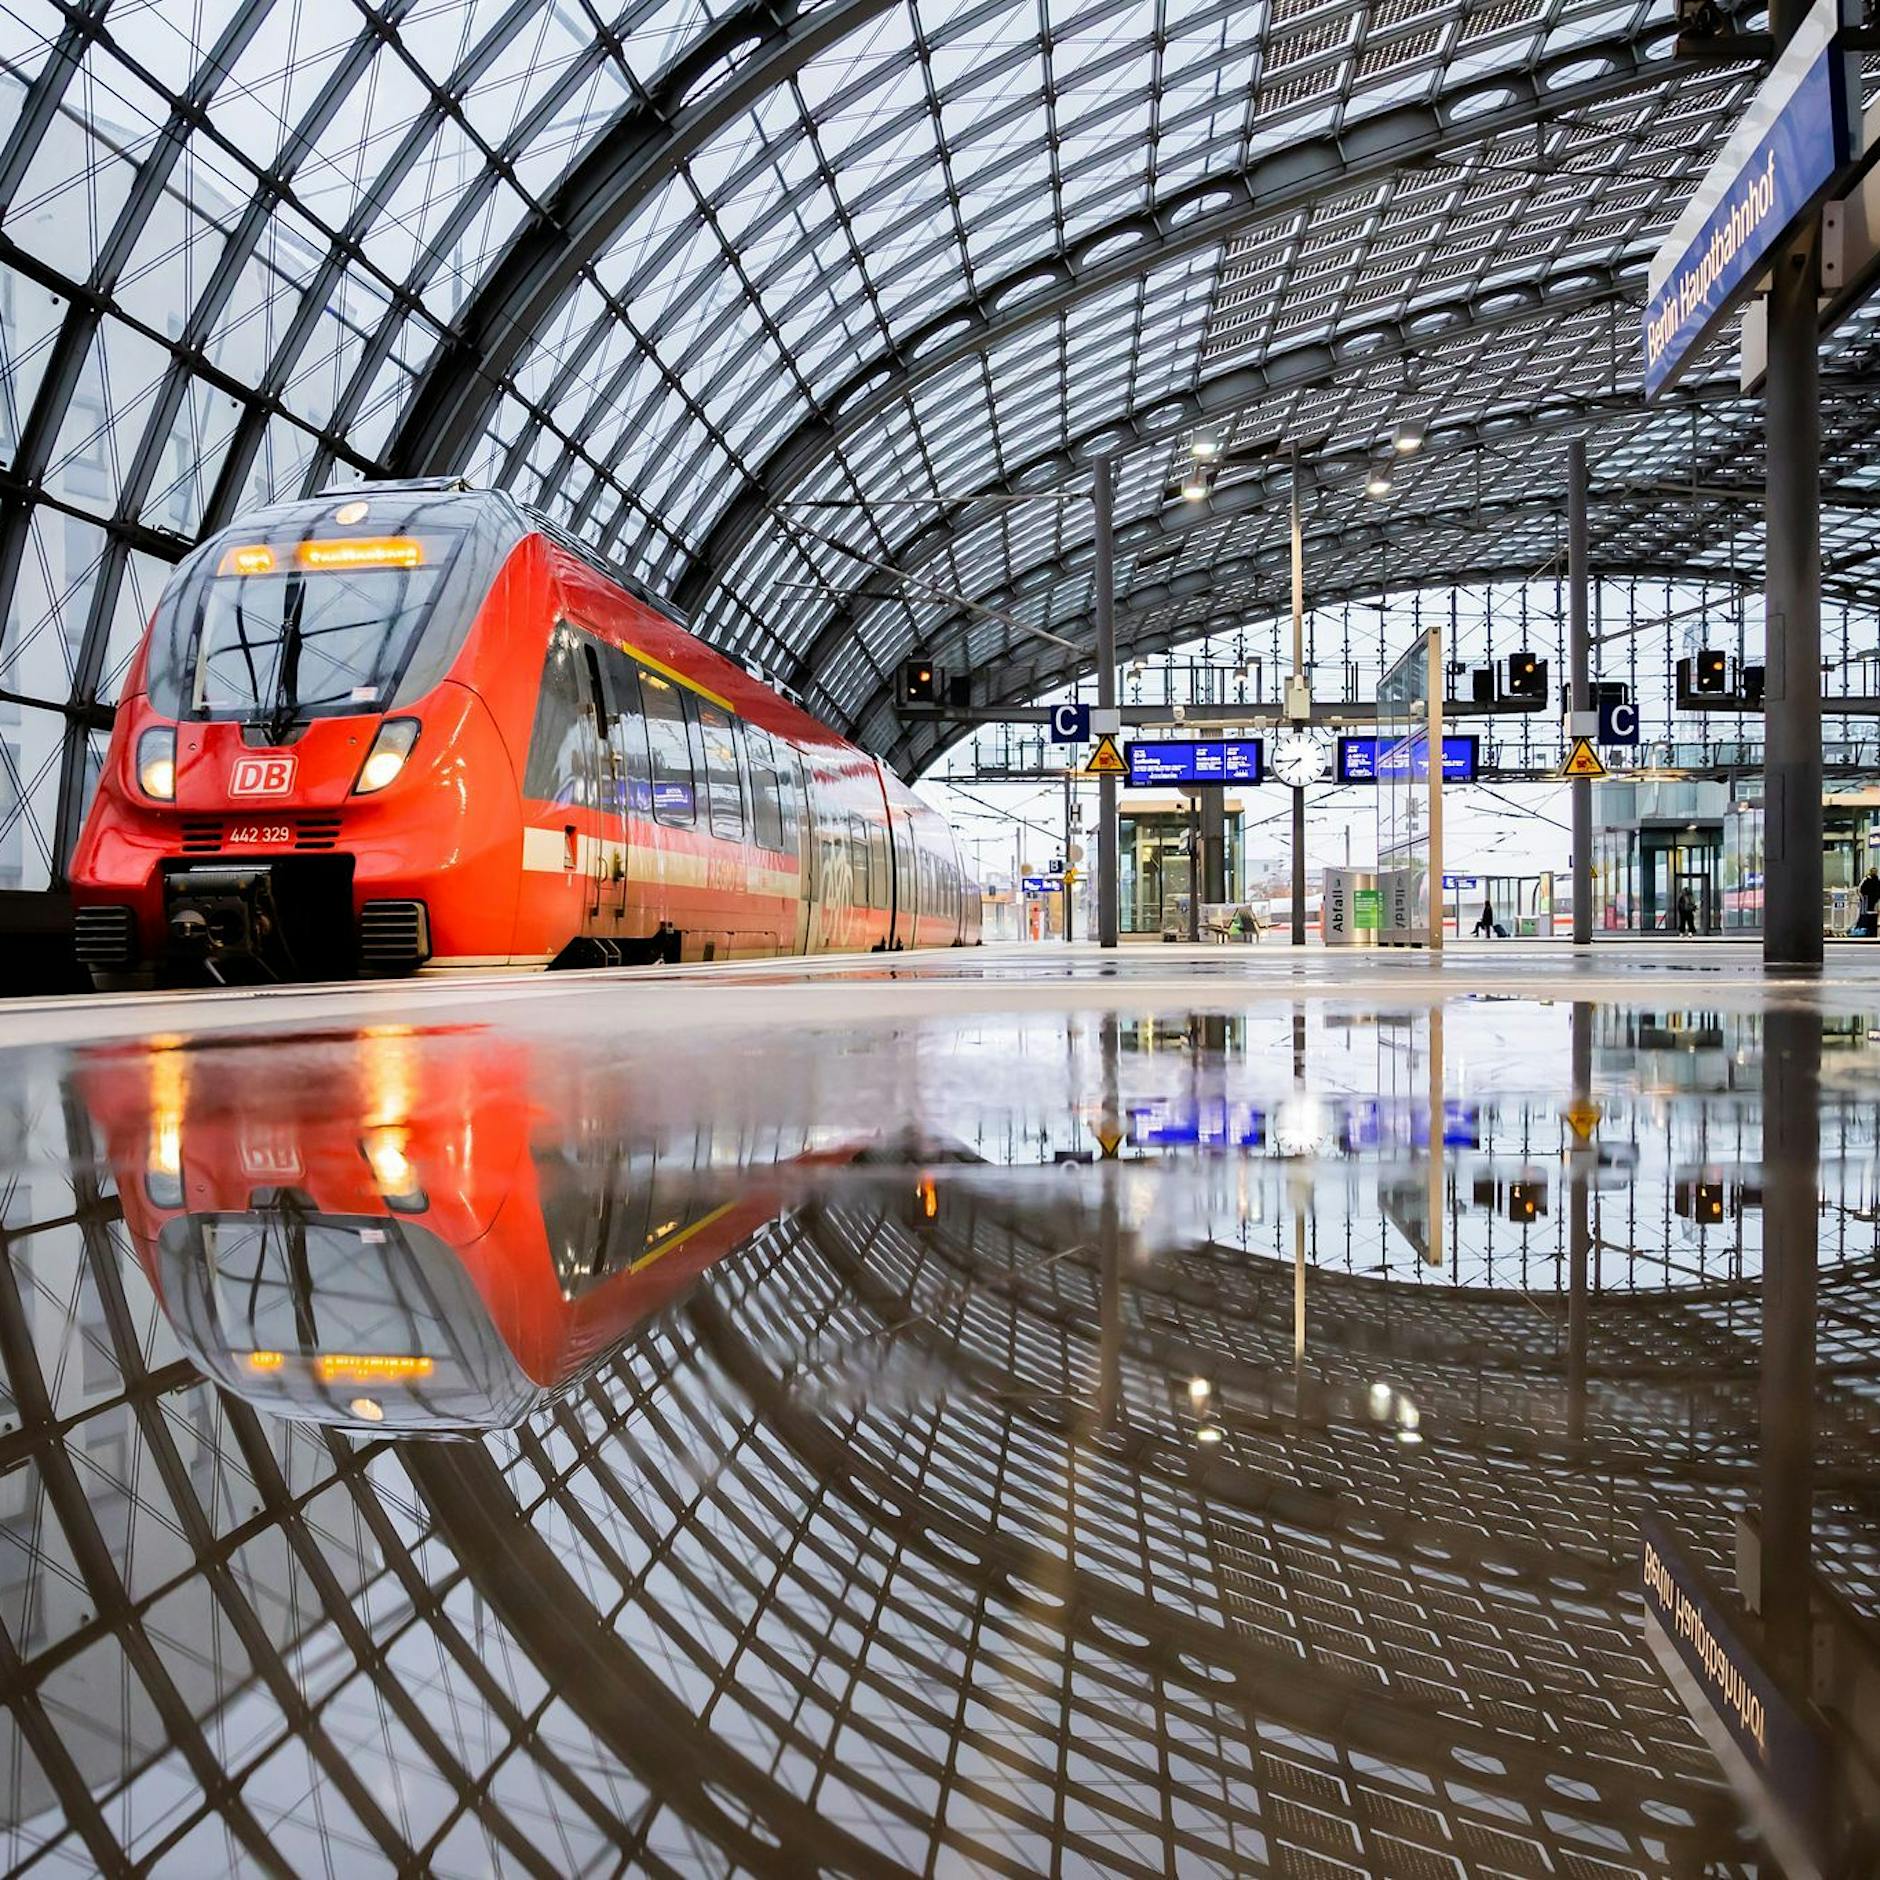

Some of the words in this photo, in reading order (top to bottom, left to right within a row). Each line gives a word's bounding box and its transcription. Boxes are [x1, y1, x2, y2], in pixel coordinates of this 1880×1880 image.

[1648, 296, 1679, 367] Berlin
[1679, 149, 1775, 324] Hauptbahnhof
[1055, 705, 1079, 736] C
[1611, 704, 1635, 737] C
[238, 763, 287, 791] DB
[229, 827, 259, 843] 442
[262, 826, 289, 842] 329
[1332, 889, 1344, 933] Abfall
